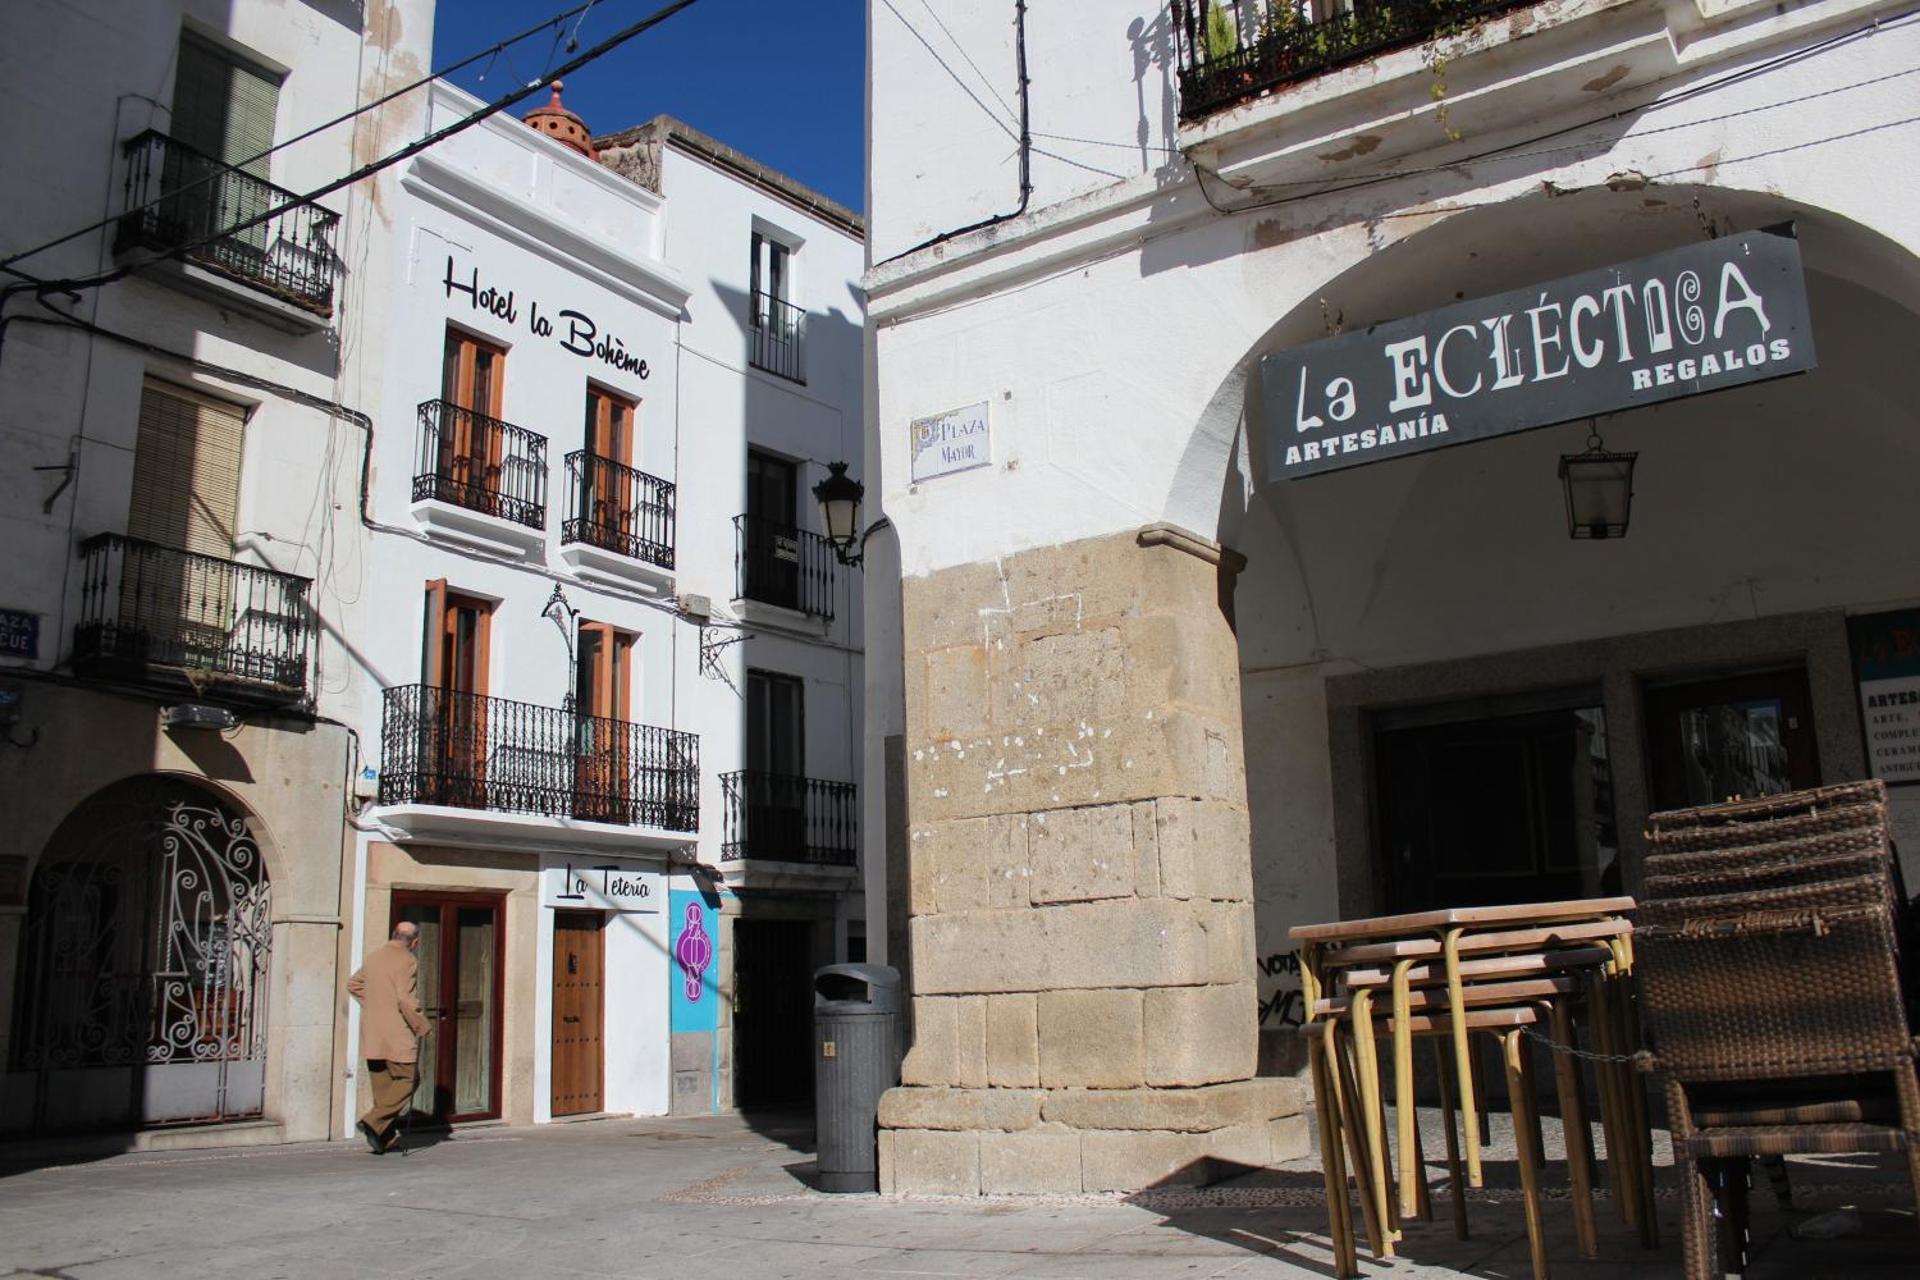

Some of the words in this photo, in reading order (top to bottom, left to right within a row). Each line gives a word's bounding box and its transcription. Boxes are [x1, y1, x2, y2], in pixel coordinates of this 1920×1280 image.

[442, 255, 517, 324] Hotel
[530, 301, 553, 337] la
[559, 309, 650, 380] Bohème
[1631, 338, 1791, 391] REGALOS
[1295, 365, 1357, 433] La
[941, 419, 985, 441] PLAZA
[1285, 411, 1449, 466] ARTESANÍA
[941, 444, 975, 463] MAYOR
[1868, 690, 1920, 709] ARTES
[556, 863, 588, 900] La
[593, 865, 650, 898] Tetería
